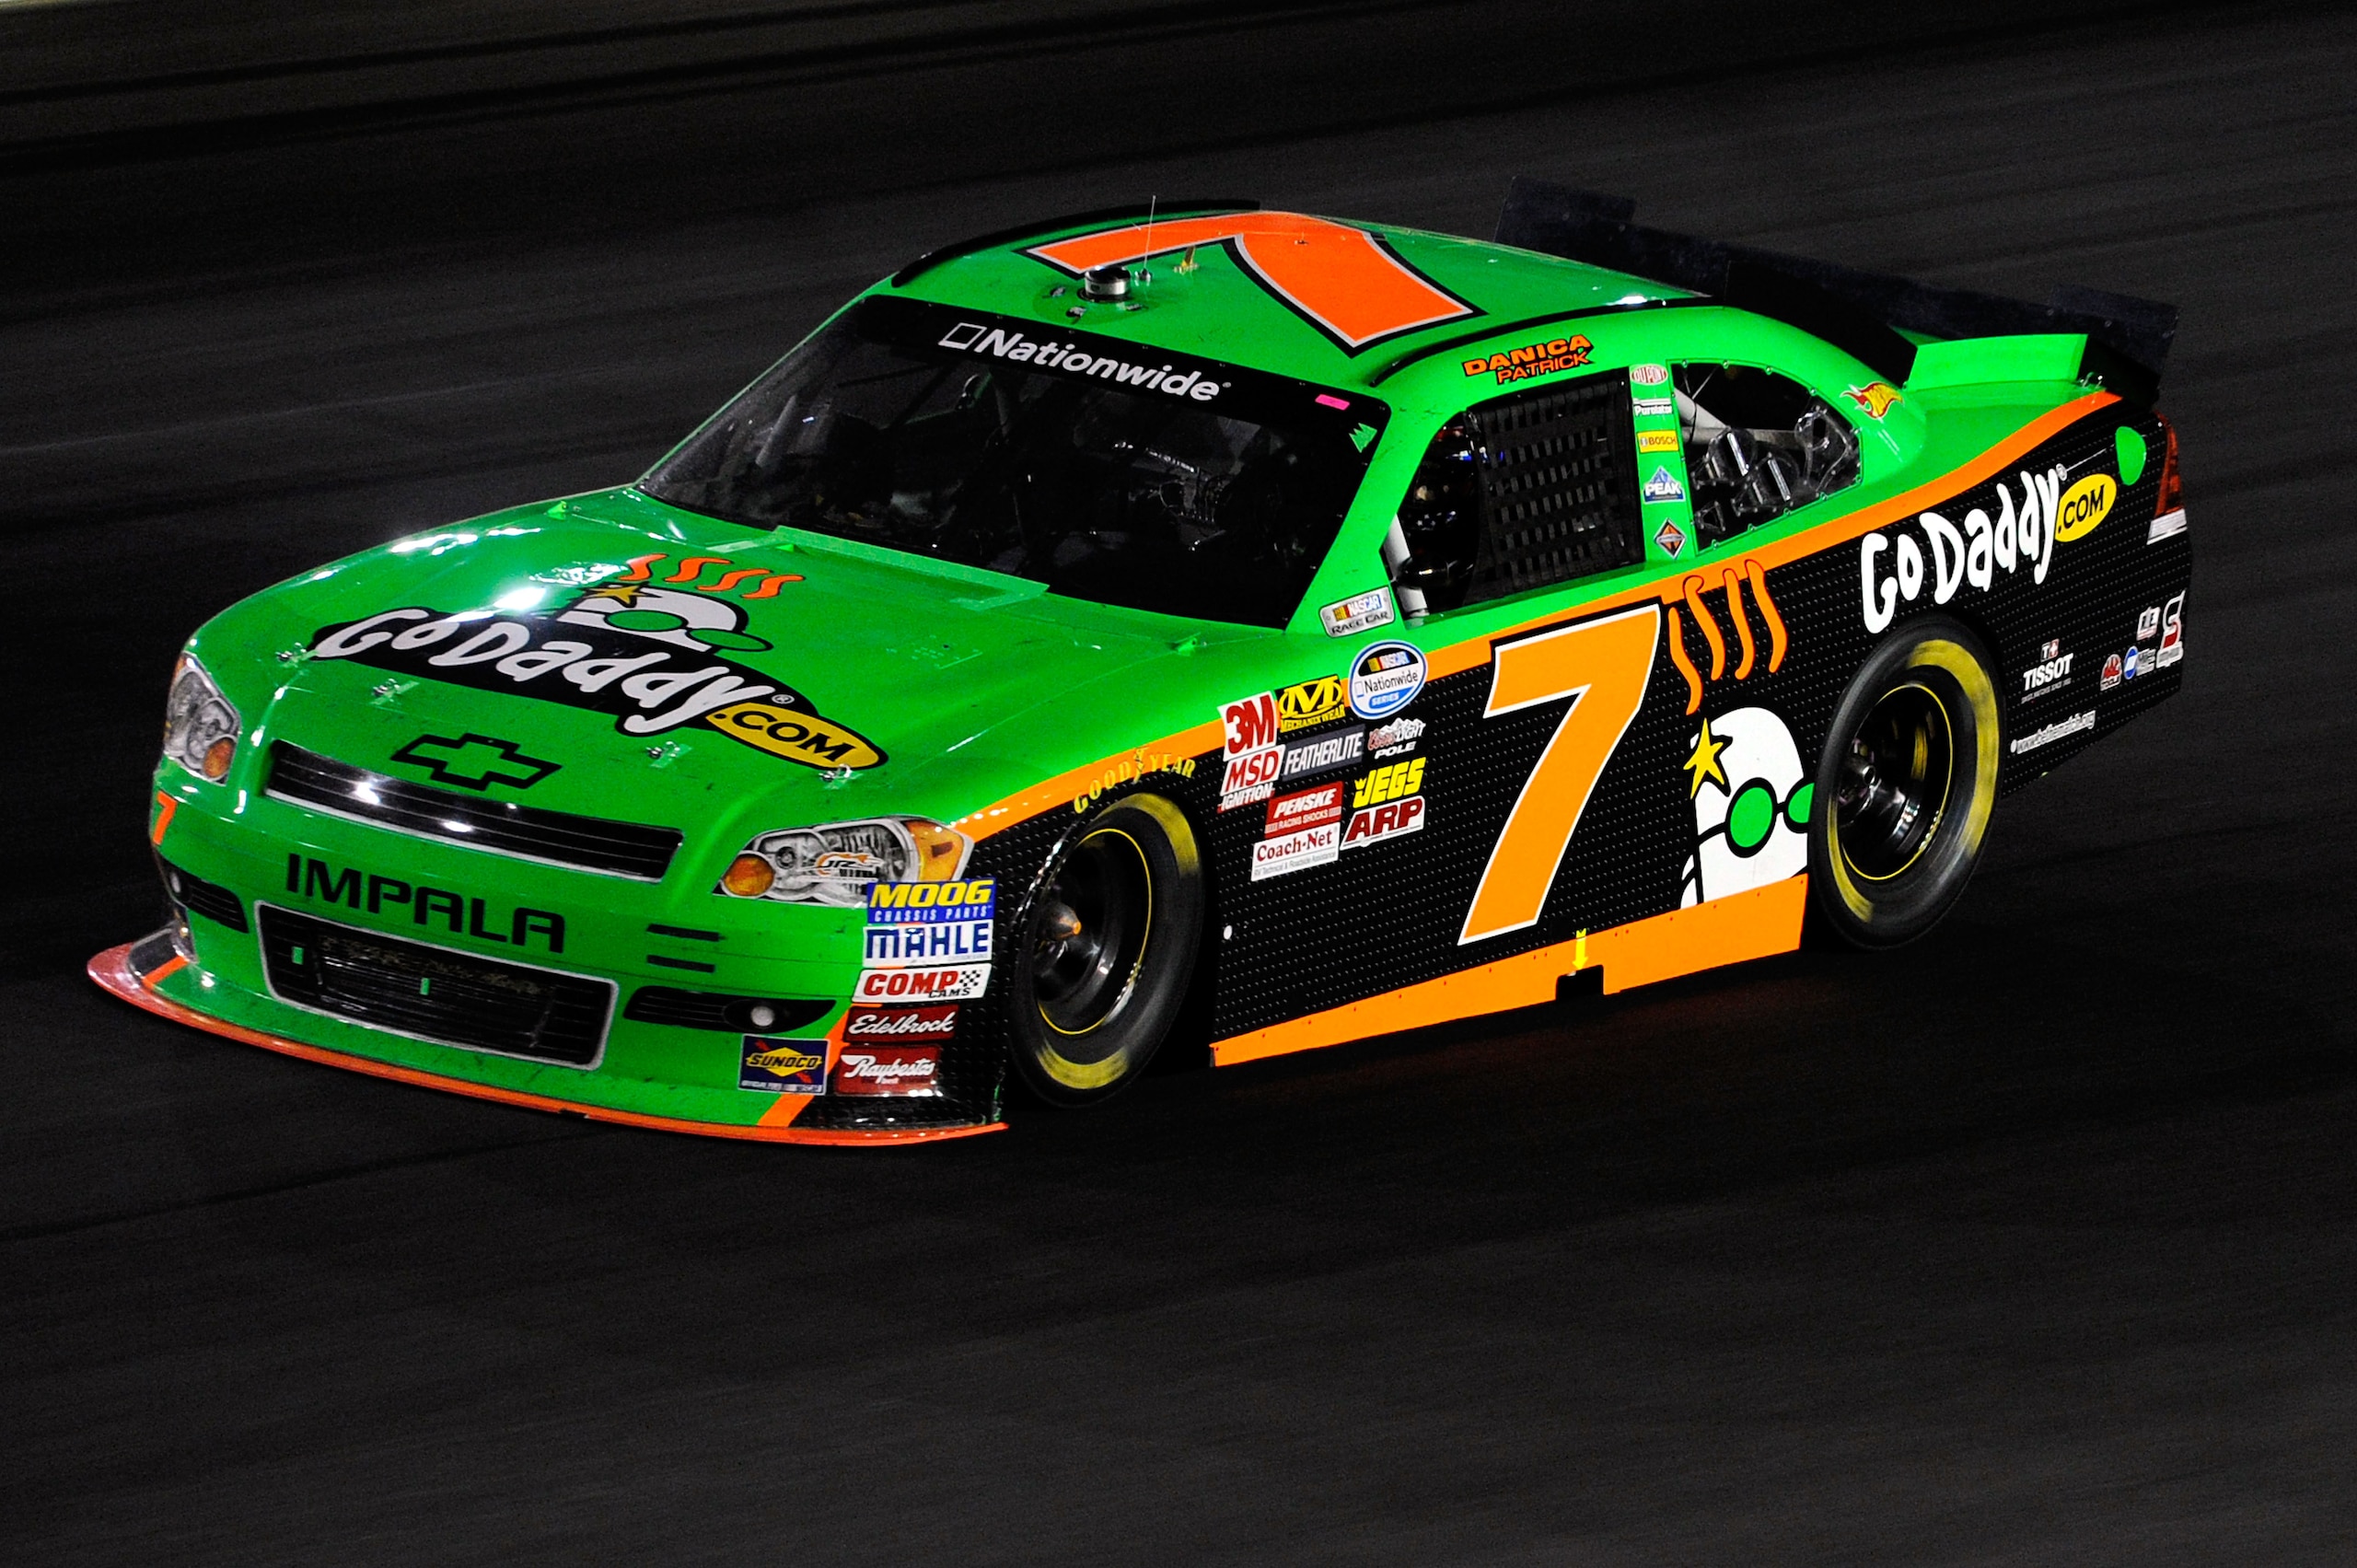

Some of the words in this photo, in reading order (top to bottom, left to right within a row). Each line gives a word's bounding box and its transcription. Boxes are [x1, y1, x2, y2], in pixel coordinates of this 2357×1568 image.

[1025, 210, 1475, 348] 7
[973, 329, 1220, 401] Nationwide
[1463, 333, 1592, 377] DANICA
[1496, 350, 1591, 385] PATRICK
[1648, 436, 1677, 446] BOSCH
[1644, 482, 1682, 496] PEAK
[1347, 594, 1382, 617] NASCAR
[1331, 619, 1364, 634] RACE
[1364, 611, 1389, 623] CAR
[1379, 651, 1410, 669] NASCAR
[2022, 652, 2074, 691] TISSOT
[1364, 669, 1419, 693] Nationwide
[1371, 691, 1399, 706] SERIES
[1225, 693, 1276, 754] 3M
[1280, 715, 1321, 733] MECHANIX
[1322, 704, 1346, 723] WEAR
[1283, 731, 1364, 776] FEATHERLITE
[1374, 740, 1417, 760] POLE
[1225, 750, 1280, 794] MSD
[1353, 757, 1427, 808] JEGS
[1457, 604, 1662, 947] 7
[1221, 783, 1273, 812] IGNITION
[1272, 787, 1337, 819] PENSKE
[152, 789, 179, 846] 7
[1278, 816, 1303, 830] RACING
[1303, 809, 1329, 823] SHOCKS
[1344, 798, 1423, 842] ARP
[1256, 829, 1332, 862] Coach-Net
[285, 853, 566, 955] IMPALA
[869, 879, 994, 909] MOOG
[874, 909, 937, 923] CHASSIS
[945, 904, 988, 920] PARTS
[865, 922, 990, 959] MAHLE
[863, 970, 959, 996] COMP
[928, 987, 971, 999] CAMS
[847, 1011, 957, 1035] Edelbrock
[749, 1054, 819, 1068] SUNOCO
[840, 1054, 936, 1085] Raybestos
